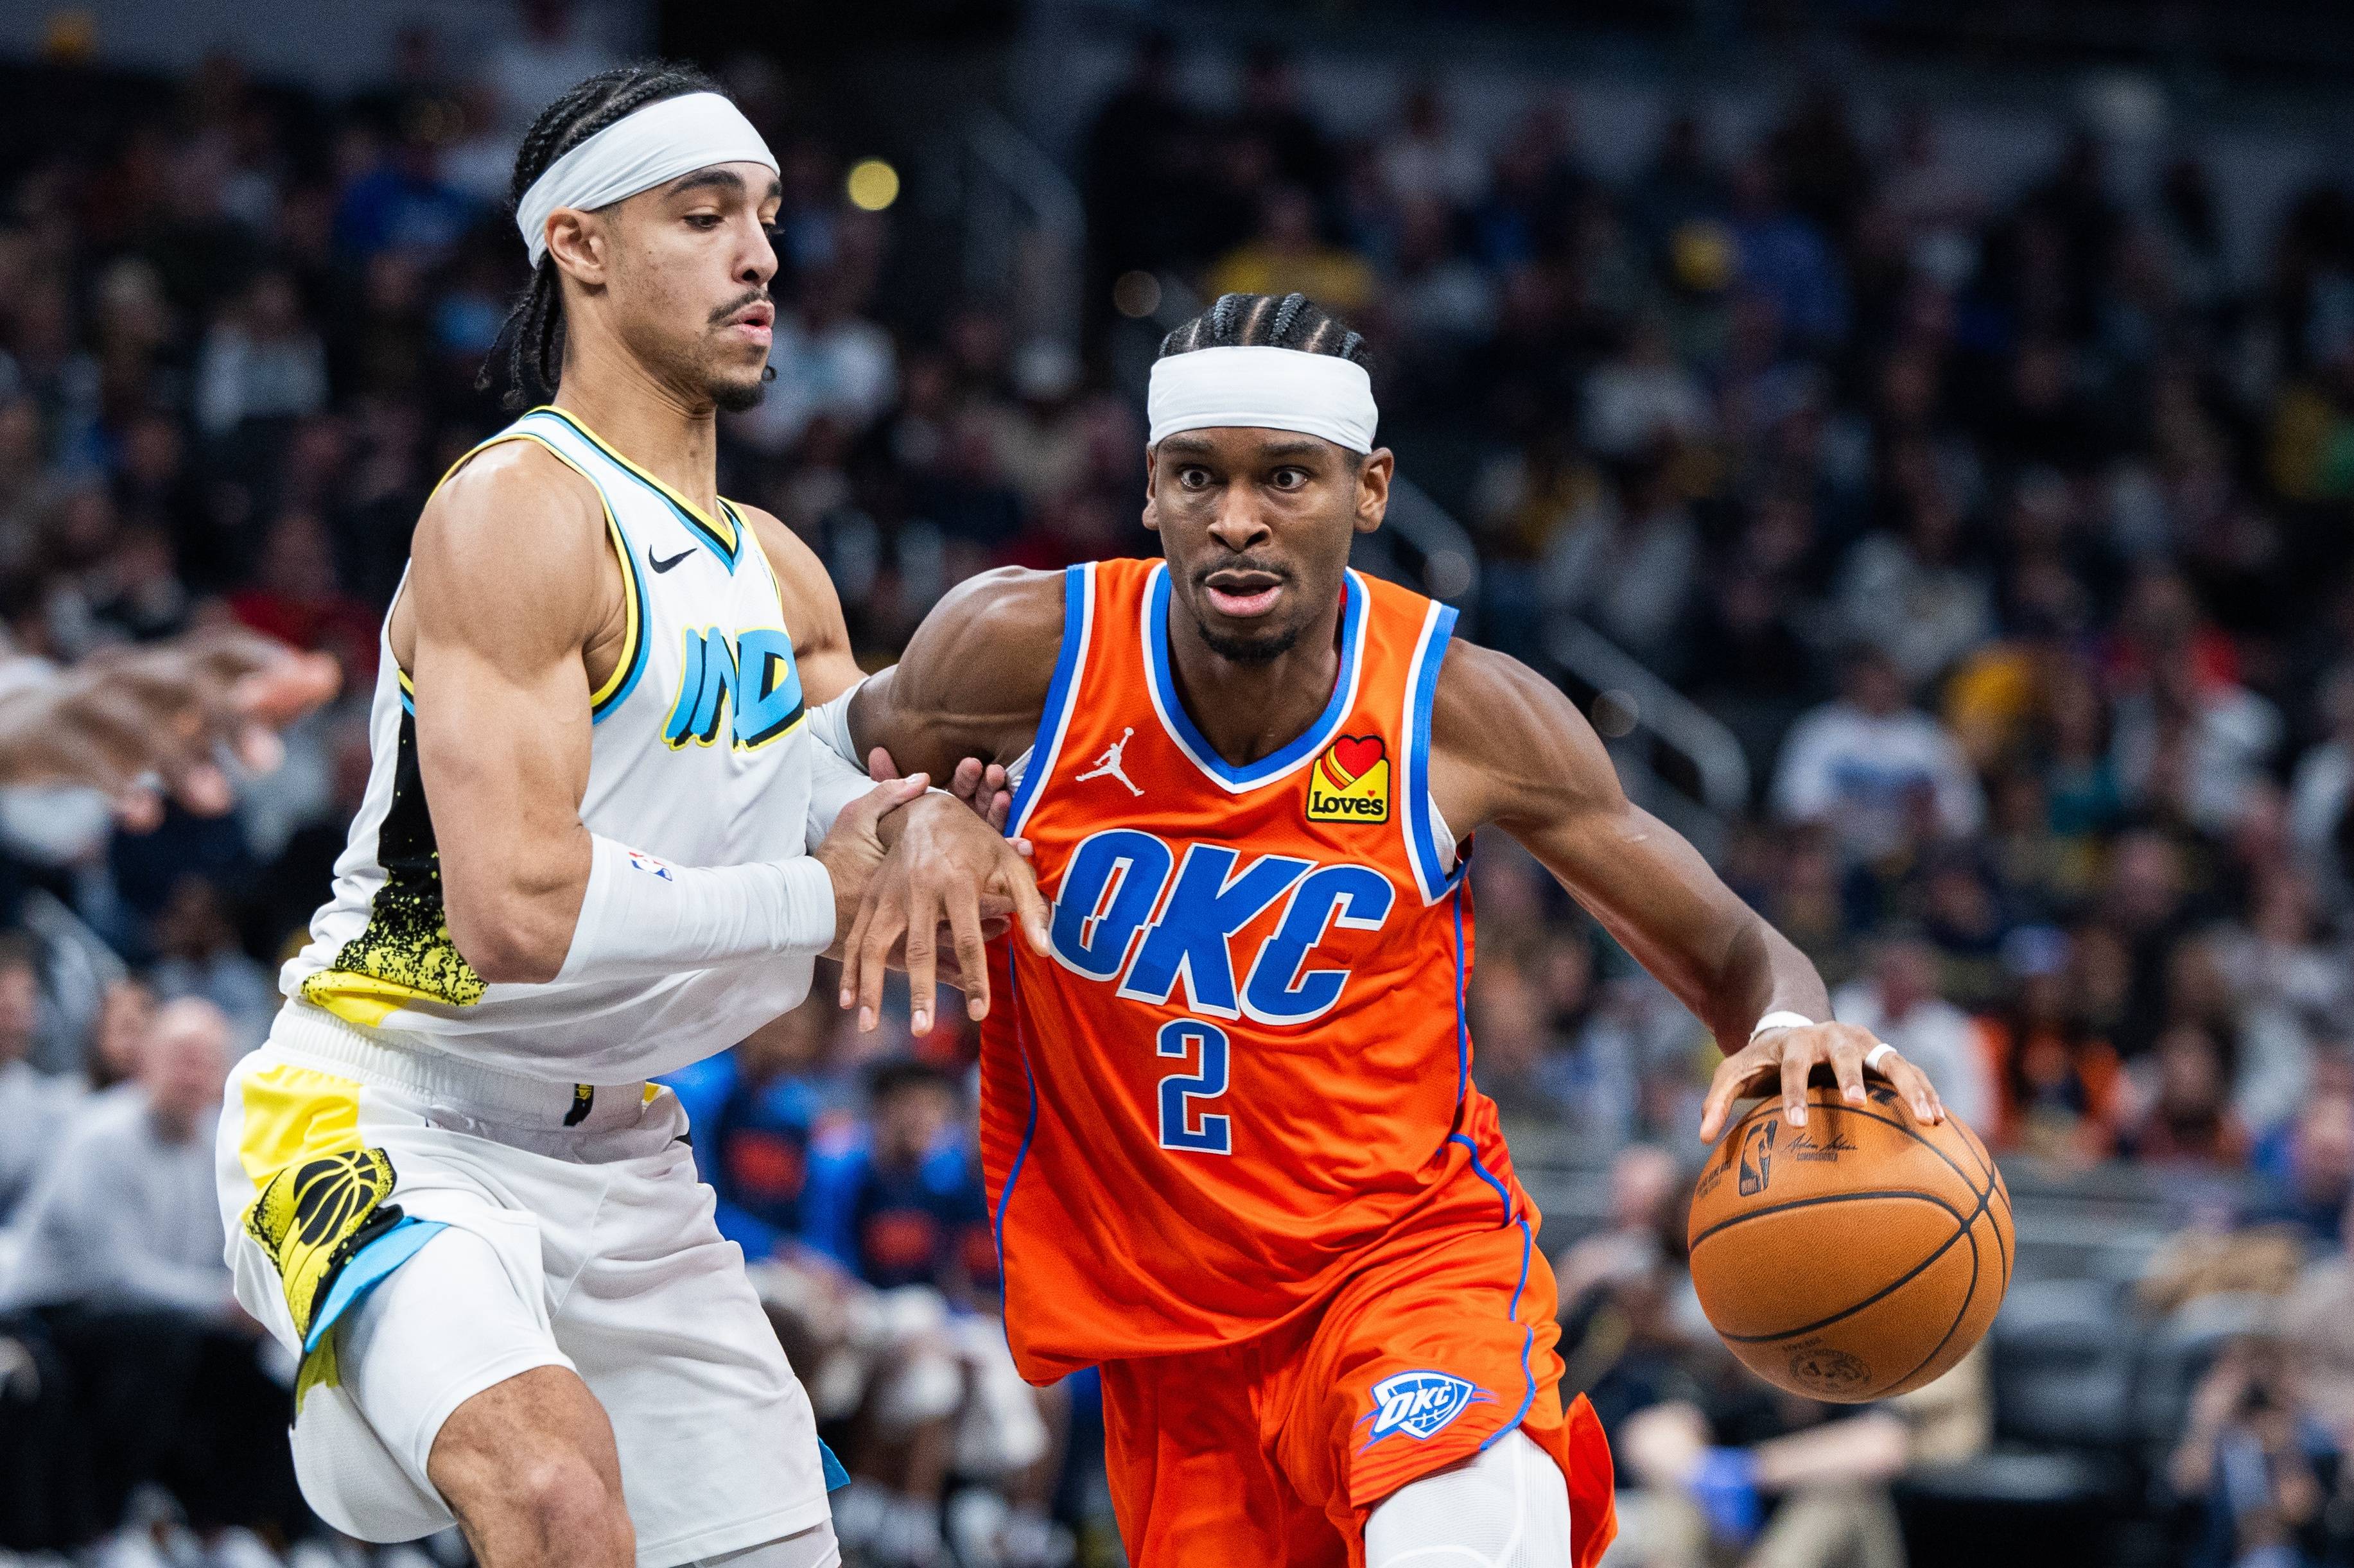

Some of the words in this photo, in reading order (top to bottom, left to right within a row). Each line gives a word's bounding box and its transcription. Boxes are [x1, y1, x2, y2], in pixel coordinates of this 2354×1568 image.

[661, 624, 805, 753] IND
[1051, 828, 1395, 1025] OKC
[1156, 1018, 1232, 1155] 2
[1374, 1385, 1452, 1433] OKC
